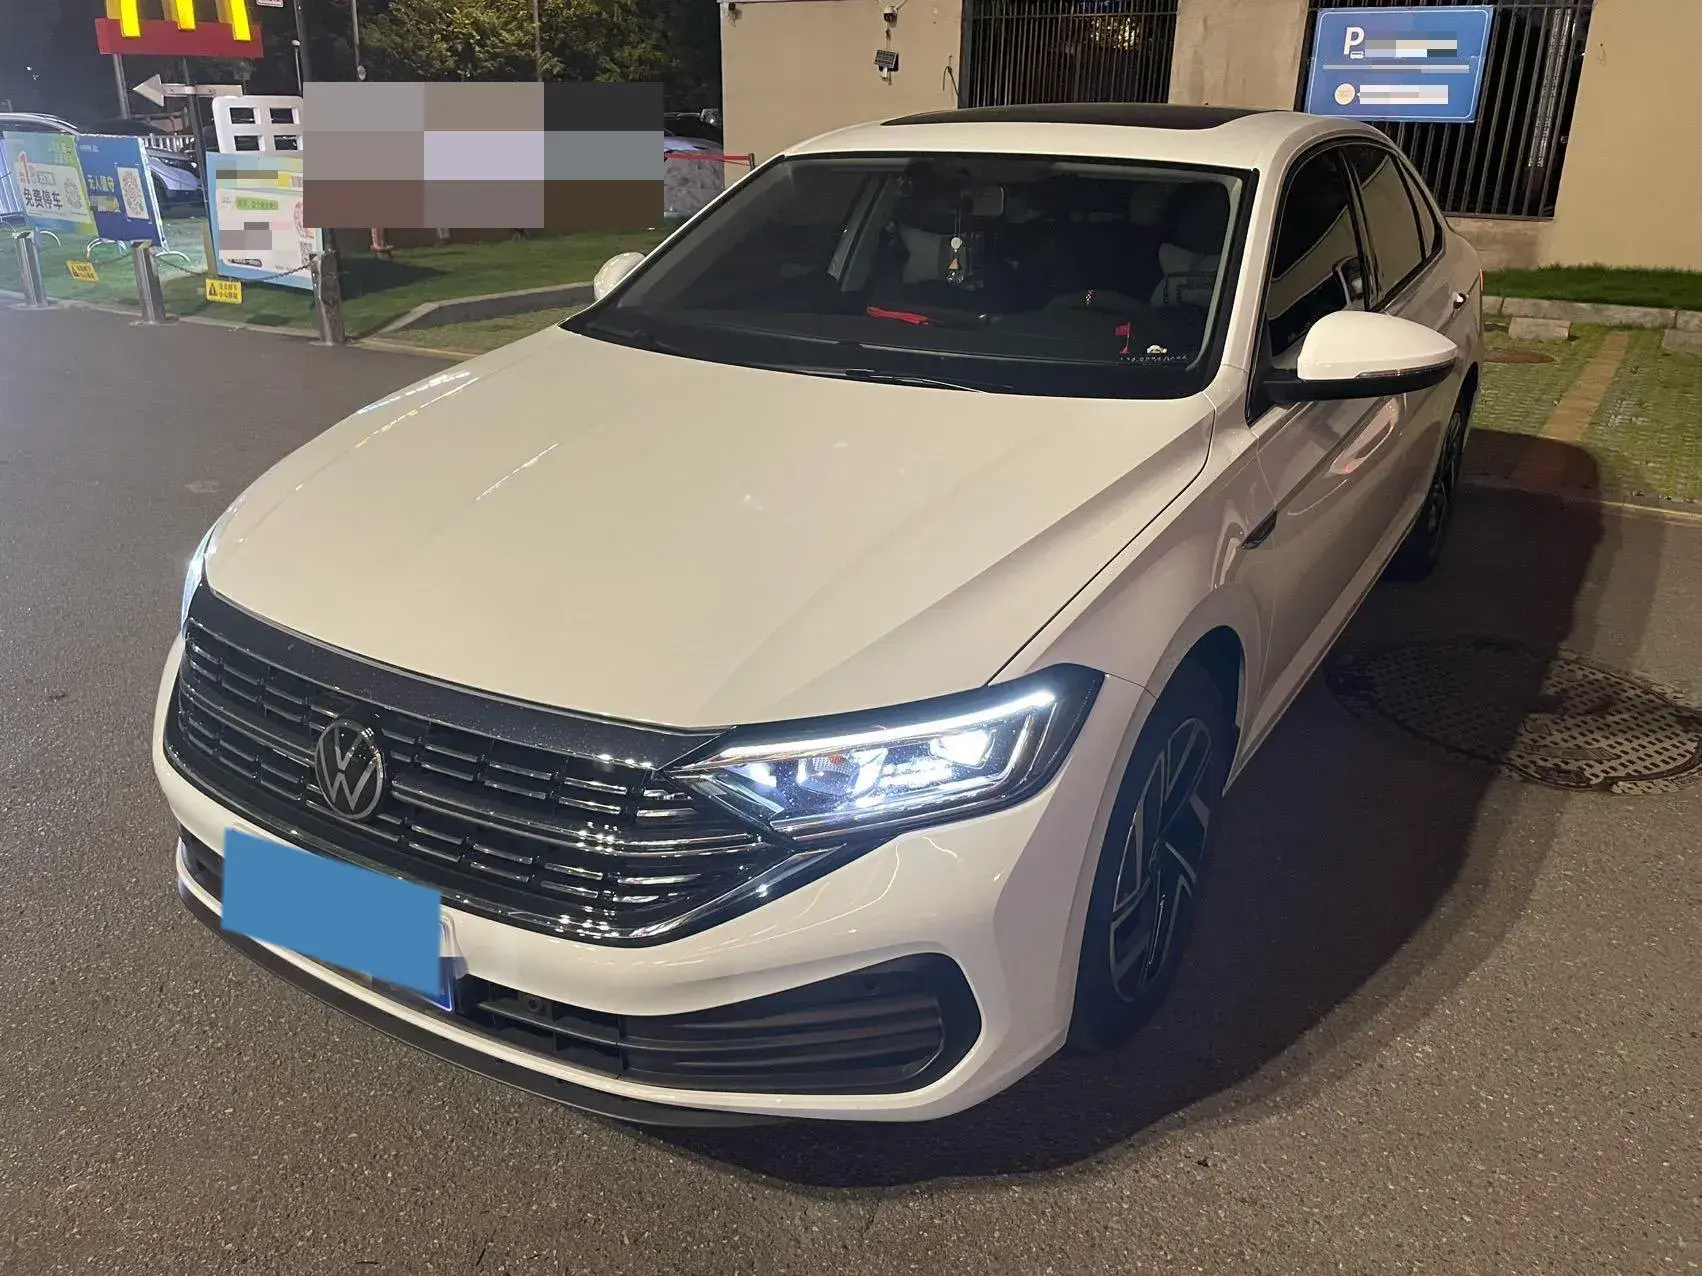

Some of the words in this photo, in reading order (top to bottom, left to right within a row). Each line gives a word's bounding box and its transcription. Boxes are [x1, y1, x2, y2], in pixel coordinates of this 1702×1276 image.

[1343, 26, 1365, 56] P
[23, 187, 63, 210] 免费停车
